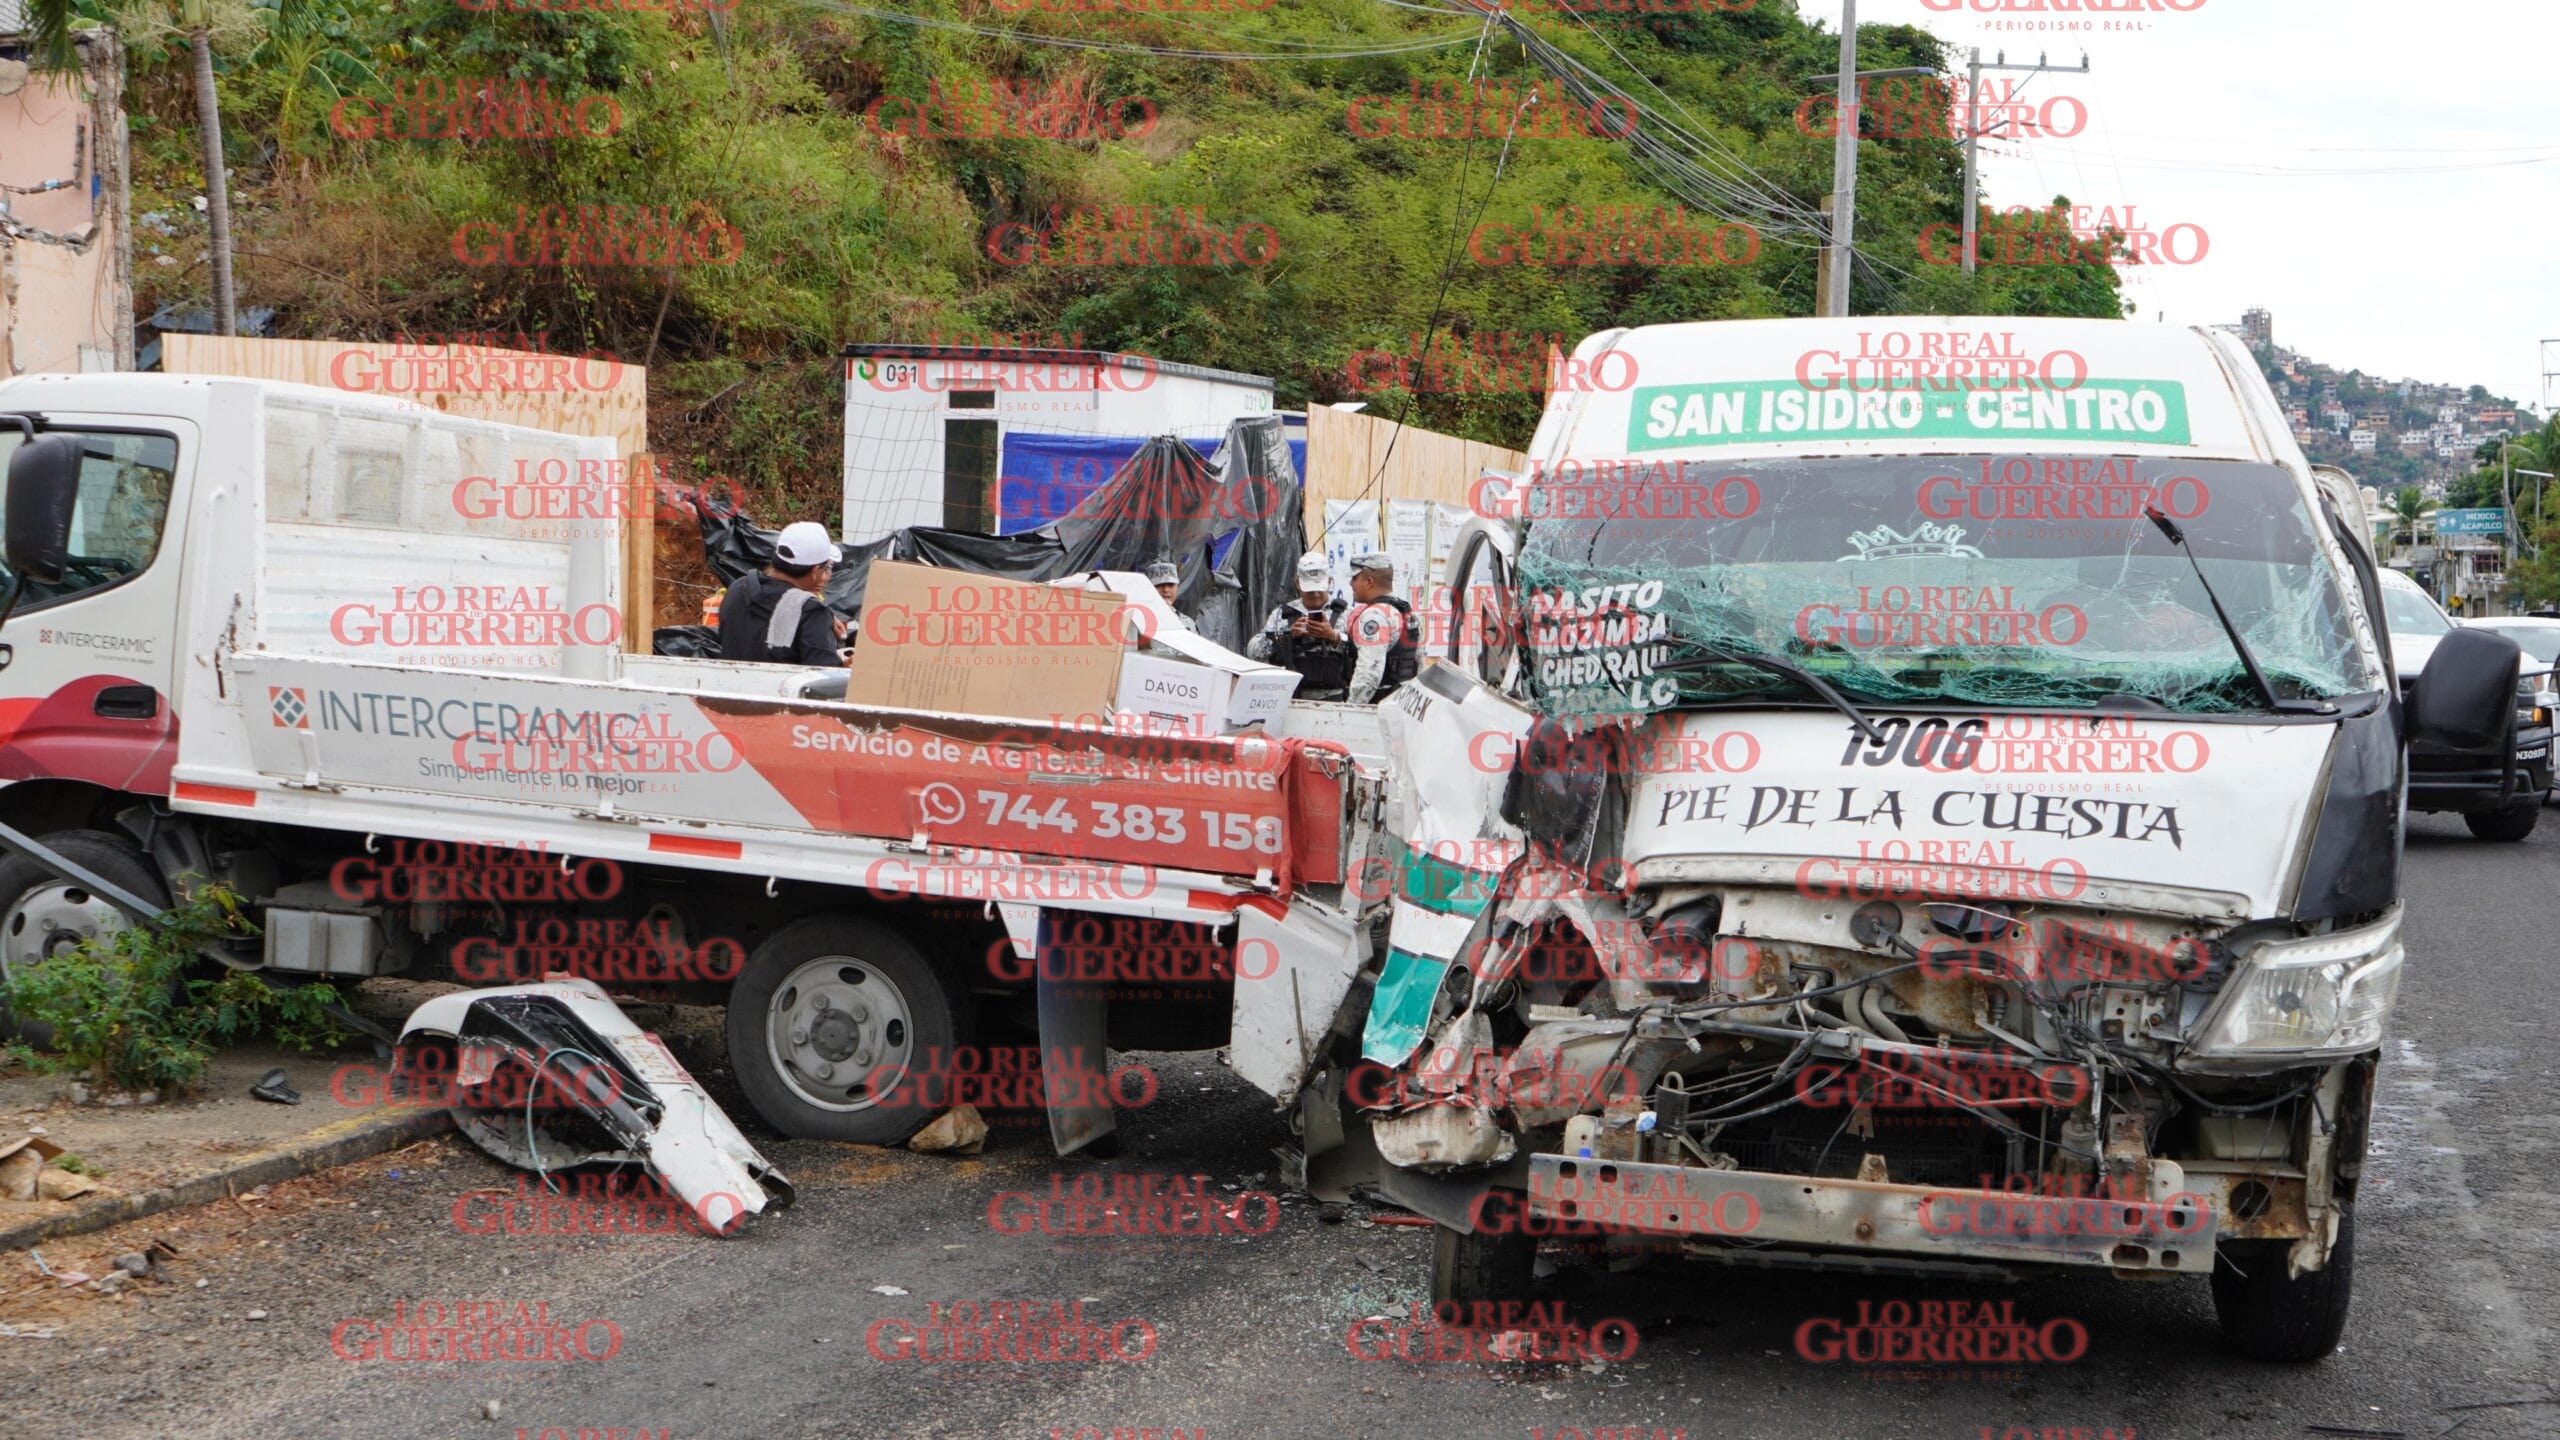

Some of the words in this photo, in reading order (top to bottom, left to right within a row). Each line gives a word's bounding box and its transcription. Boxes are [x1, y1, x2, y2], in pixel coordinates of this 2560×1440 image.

[886, 364, 917, 383] 031
[1647, 392, 1745, 439] SAN
[1758, 389, 1922, 433] ISIDRO
[1966, 388, 2167, 433] CENTRO
[2461, 522, 2503, 530] ACAPULCO
[56, 631, 153, 654] INTERCERAMIC
[1145, 679, 1199, 699] DAVOS
[1249, 699, 1279, 709] DAVOS
[320, 690, 642, 755] INTERCERAMIC
[792, 724, 914, 757] Servicio
[922, 734, 961, 763] de
[1840, 716, 1989, 770] 1906
[420, 757, 552, 786] Simplemente
[559, 765, 578, 788] lo
[586, 772, 646, 796] mejor
[978, 790, 1078, 834] 744
[1092, 801, 1186, 844] 383
[1658, 784, 1732, 828] PIE
[1738, 786, 1820, 833] DE
[1829, 786, 1906, 831] LA
[1932, 789, 2186, 852] CUESTA
